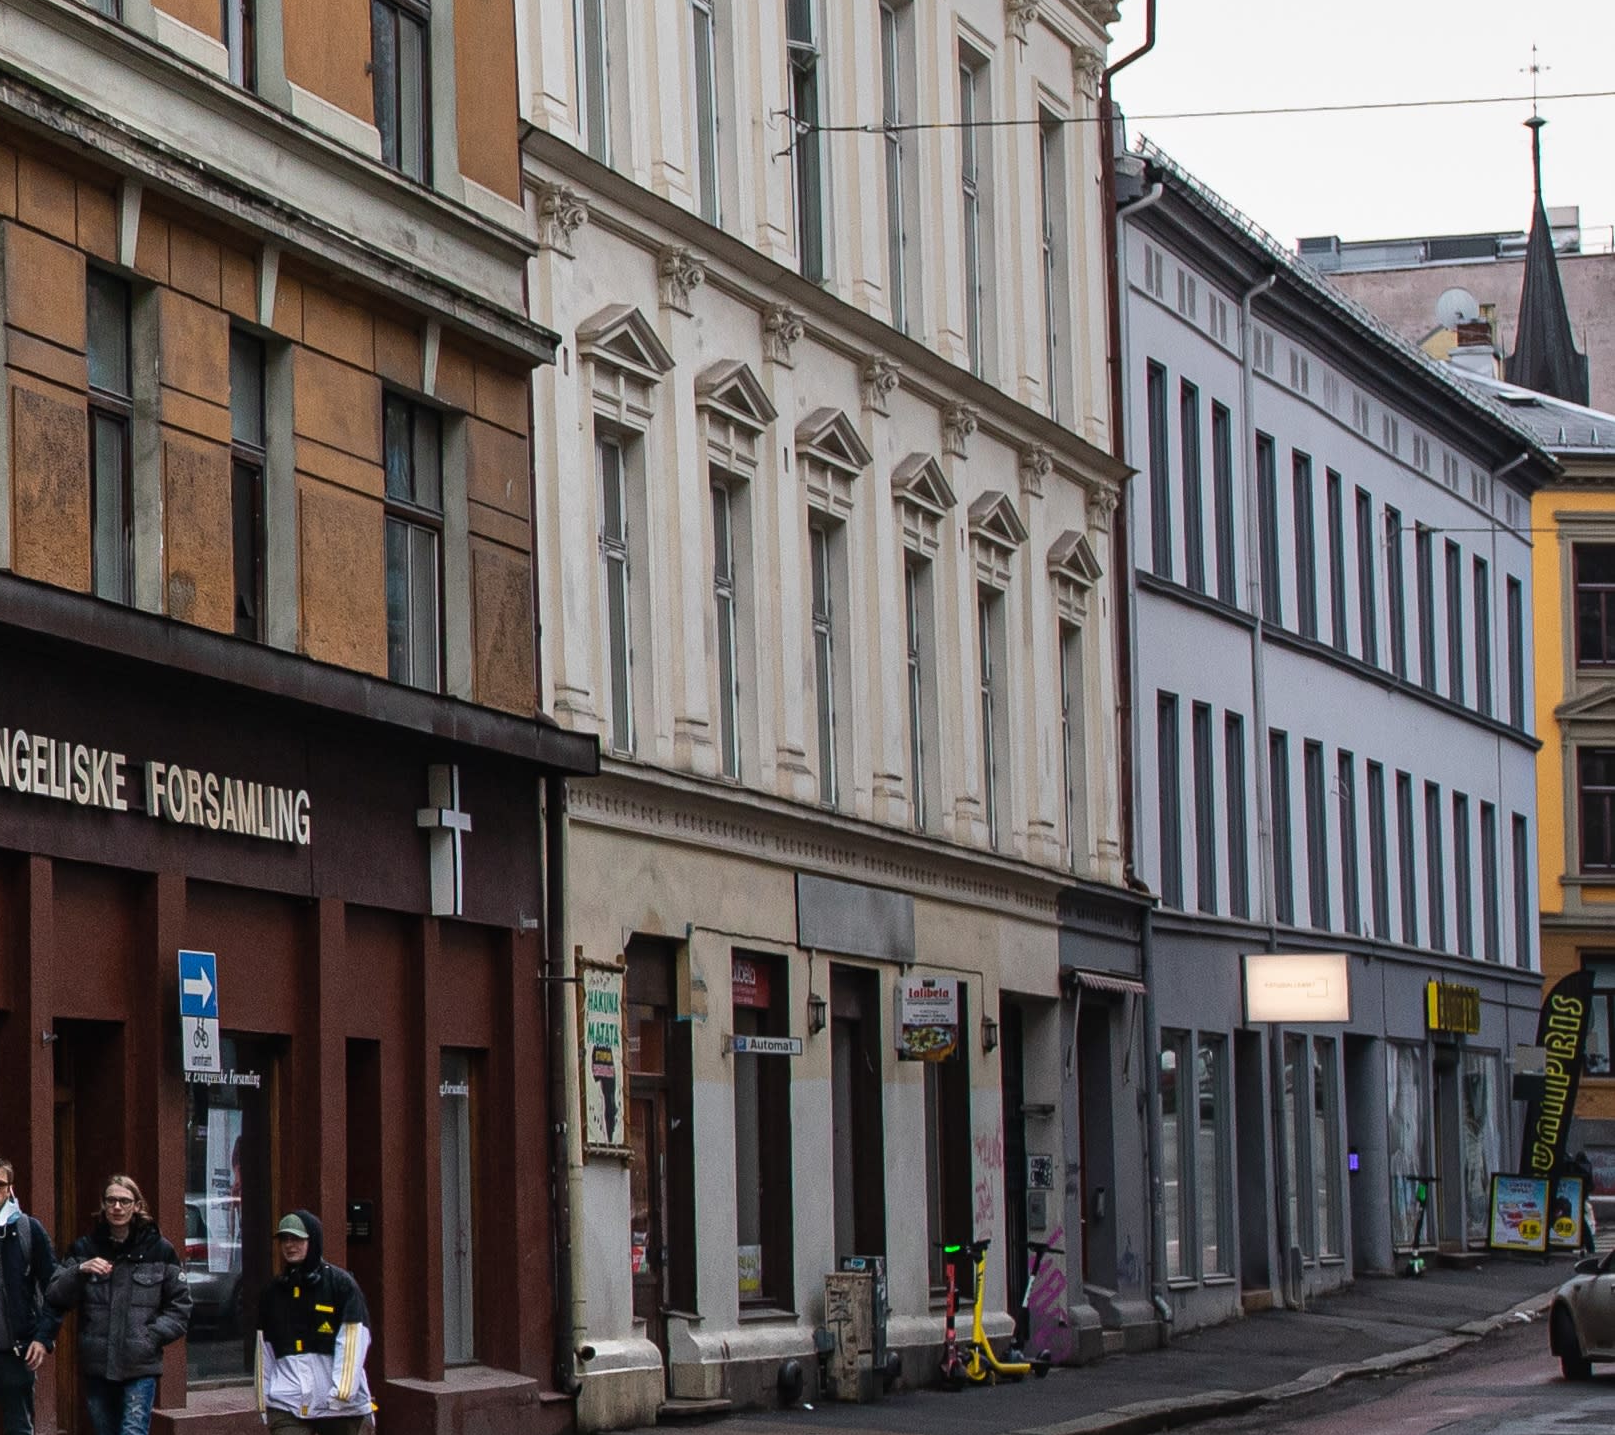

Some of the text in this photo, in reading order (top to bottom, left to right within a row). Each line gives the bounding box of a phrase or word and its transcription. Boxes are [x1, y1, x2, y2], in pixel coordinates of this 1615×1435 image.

[146, 760, 312, 846] FORSAMLING
[587, 989, 619, 1015] HAKUNA
[587, 1021, 620, 1047] MATATA
[750, 1037, 794, 1052] Automat
[1531, 994, 1584, 1176] UNNPRIS
